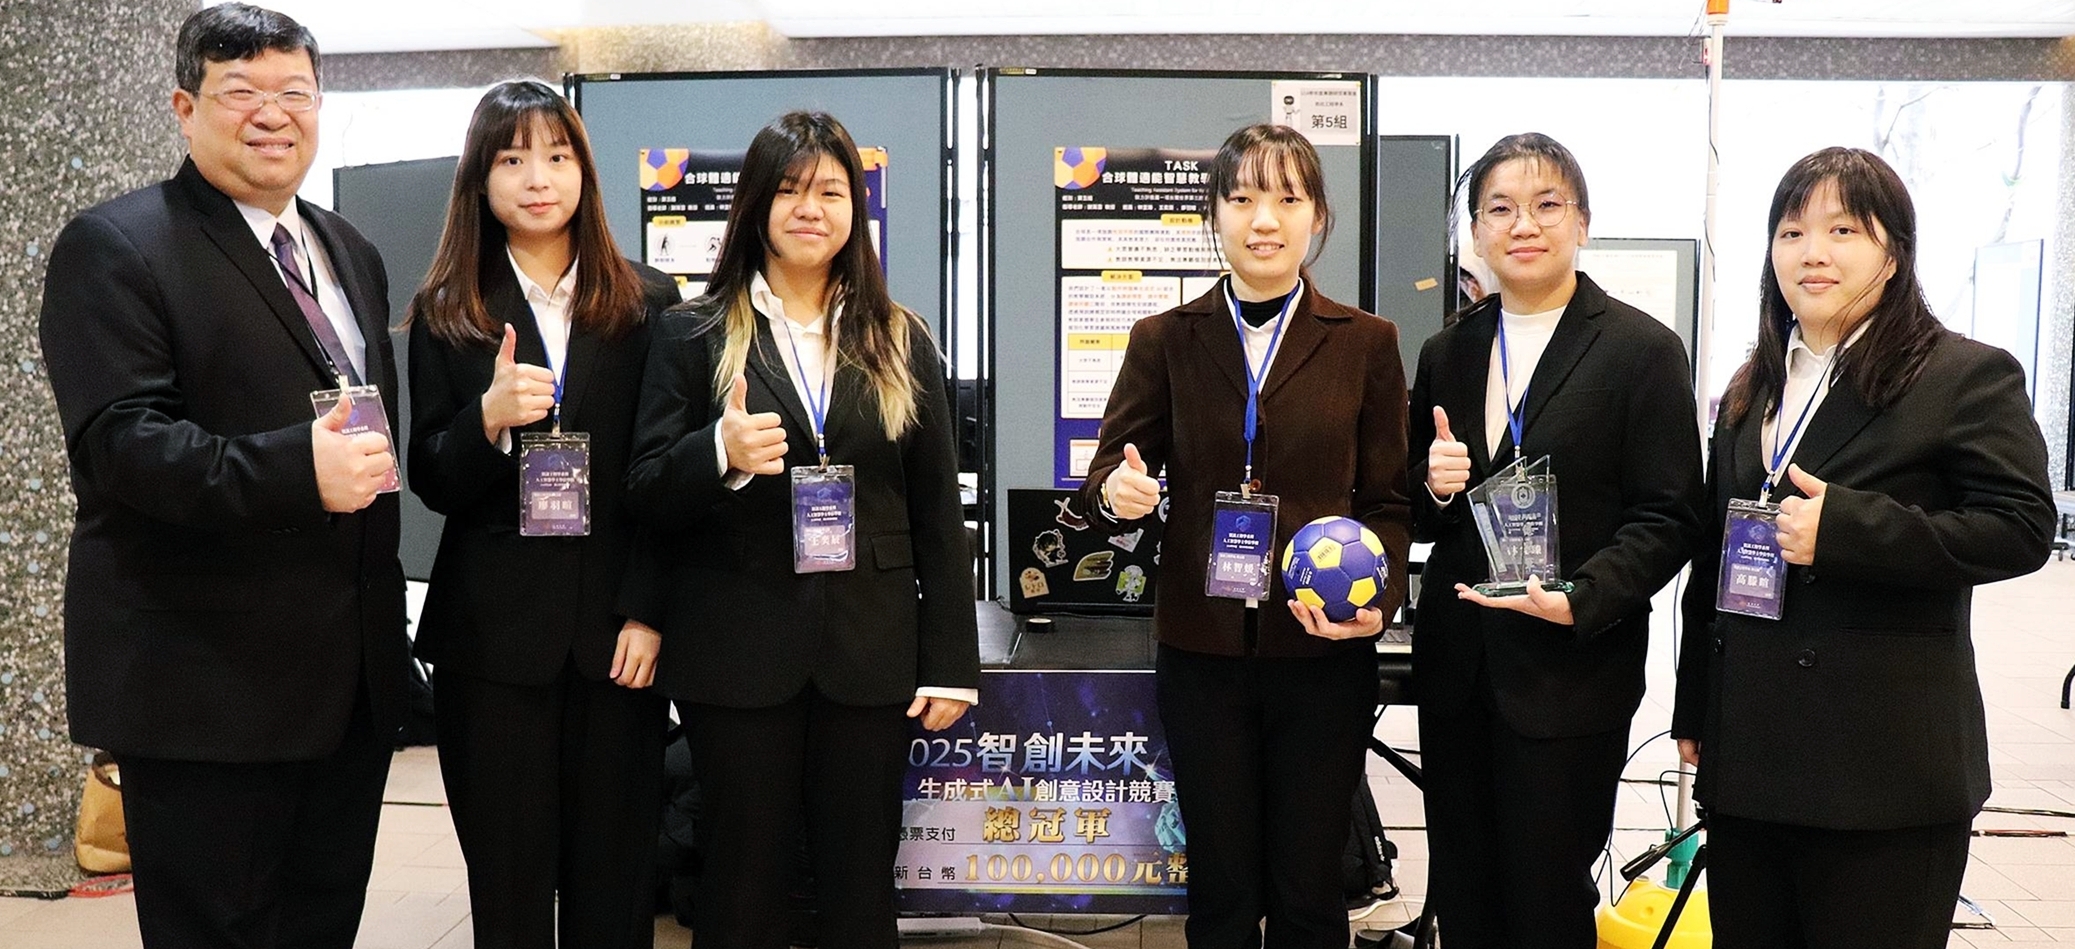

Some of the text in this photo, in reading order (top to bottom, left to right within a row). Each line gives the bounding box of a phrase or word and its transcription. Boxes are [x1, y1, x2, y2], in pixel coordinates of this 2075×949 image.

[1311, 114, 1347, 129] 第5組
[1164, 160, 1199, 171] TASK
[917, 776, 1176, 803] 生成式AI創意設計競賽
[982, 806, 1112, 843] 總冠軍
